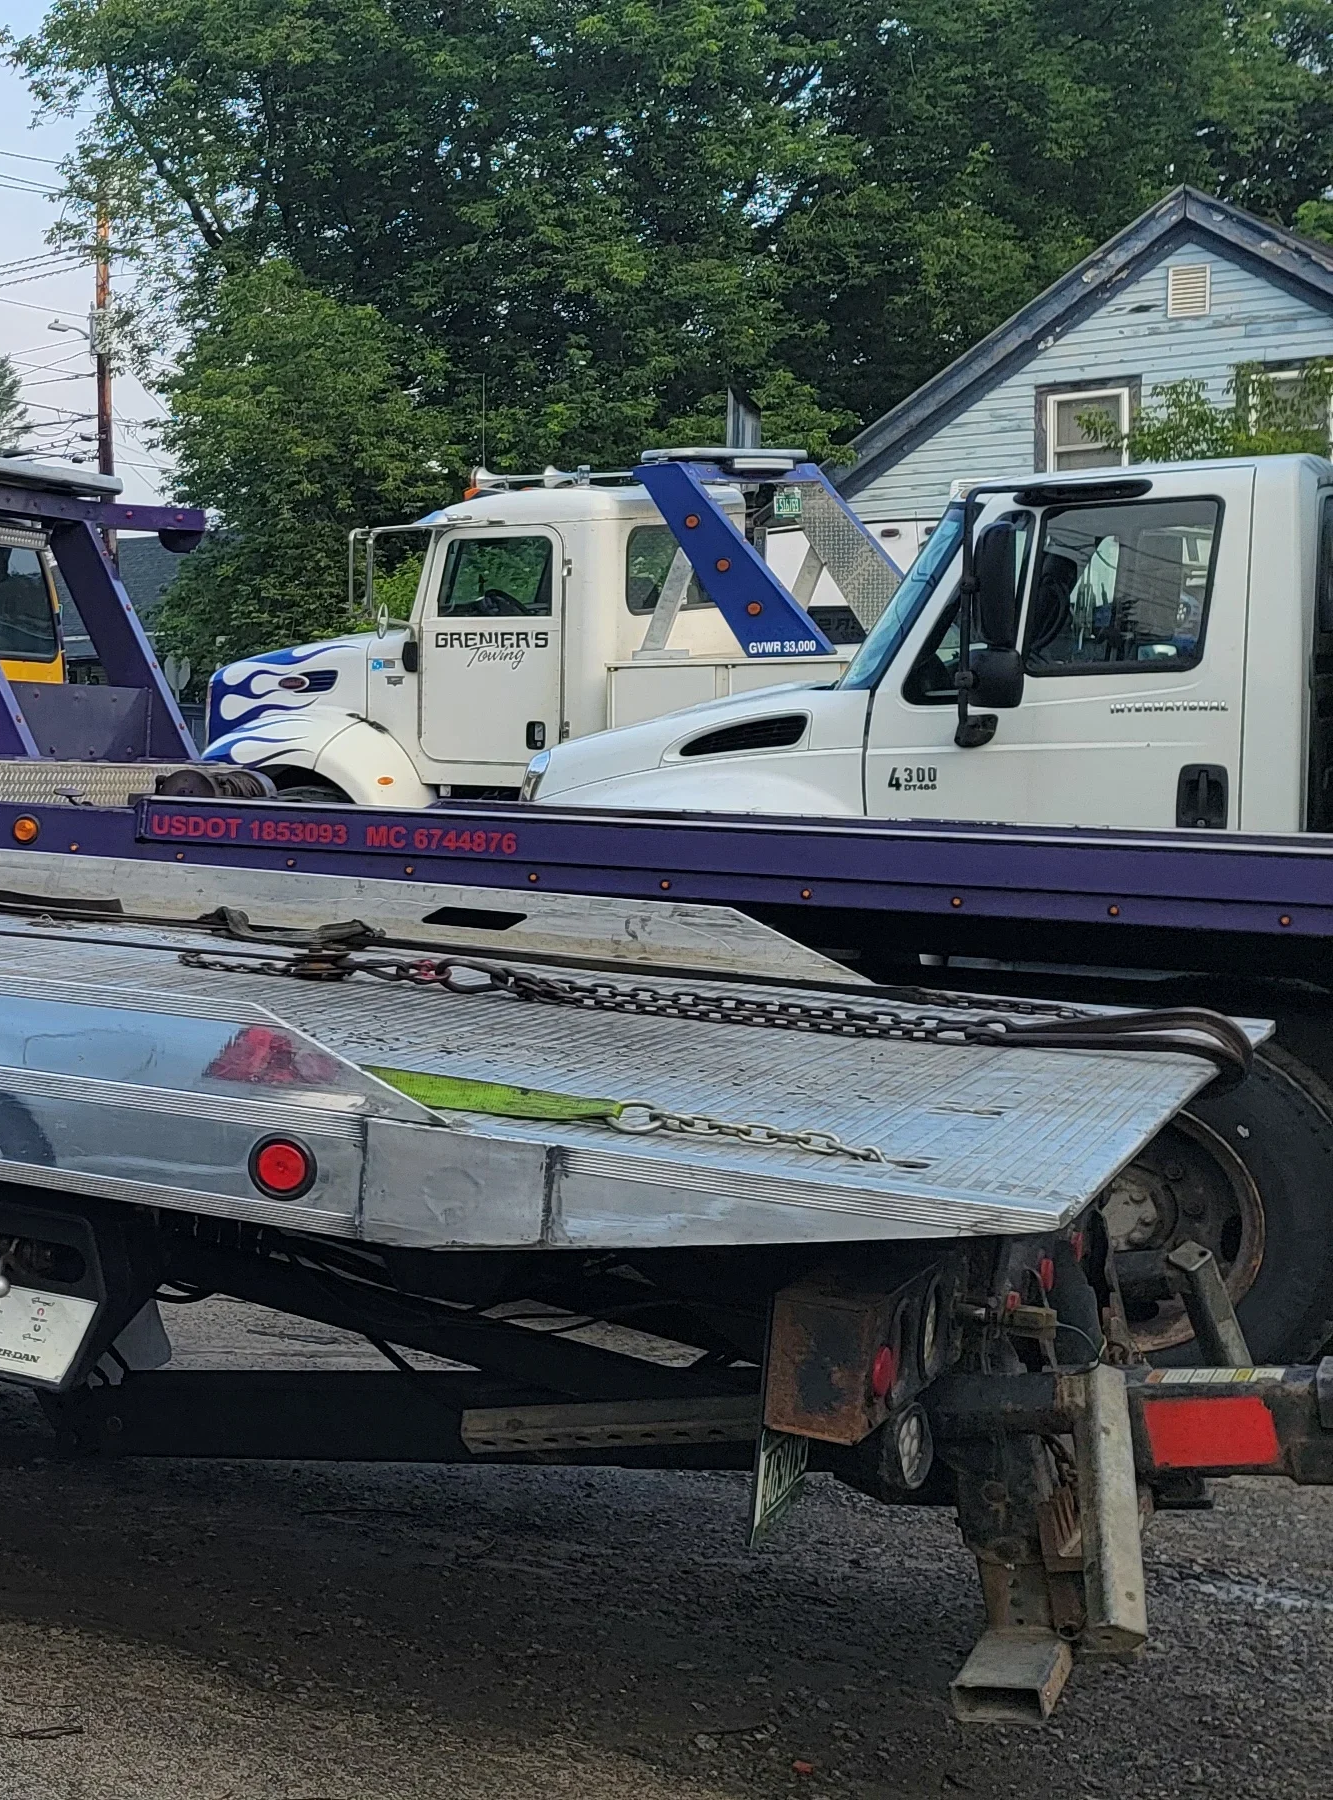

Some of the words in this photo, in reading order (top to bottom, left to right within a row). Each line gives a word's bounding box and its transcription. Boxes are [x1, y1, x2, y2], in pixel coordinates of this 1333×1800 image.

[435, 631, 549, 648] GRENIER'S
[749, 641, 781, 653] GVWR
[784, 640, 816, 654] 33,000
[467, 644, 525, 670] Towing
[1110, 701, 1229, 714] INTERNATIONAL
[887, 766, 937, 791] 4300
[152, 814, 242, 839] USDOT
[249, 820, 348, 844] 1853093
[366, 825, 407, 848] MC
[414, 828, 517, 854] 6744876
